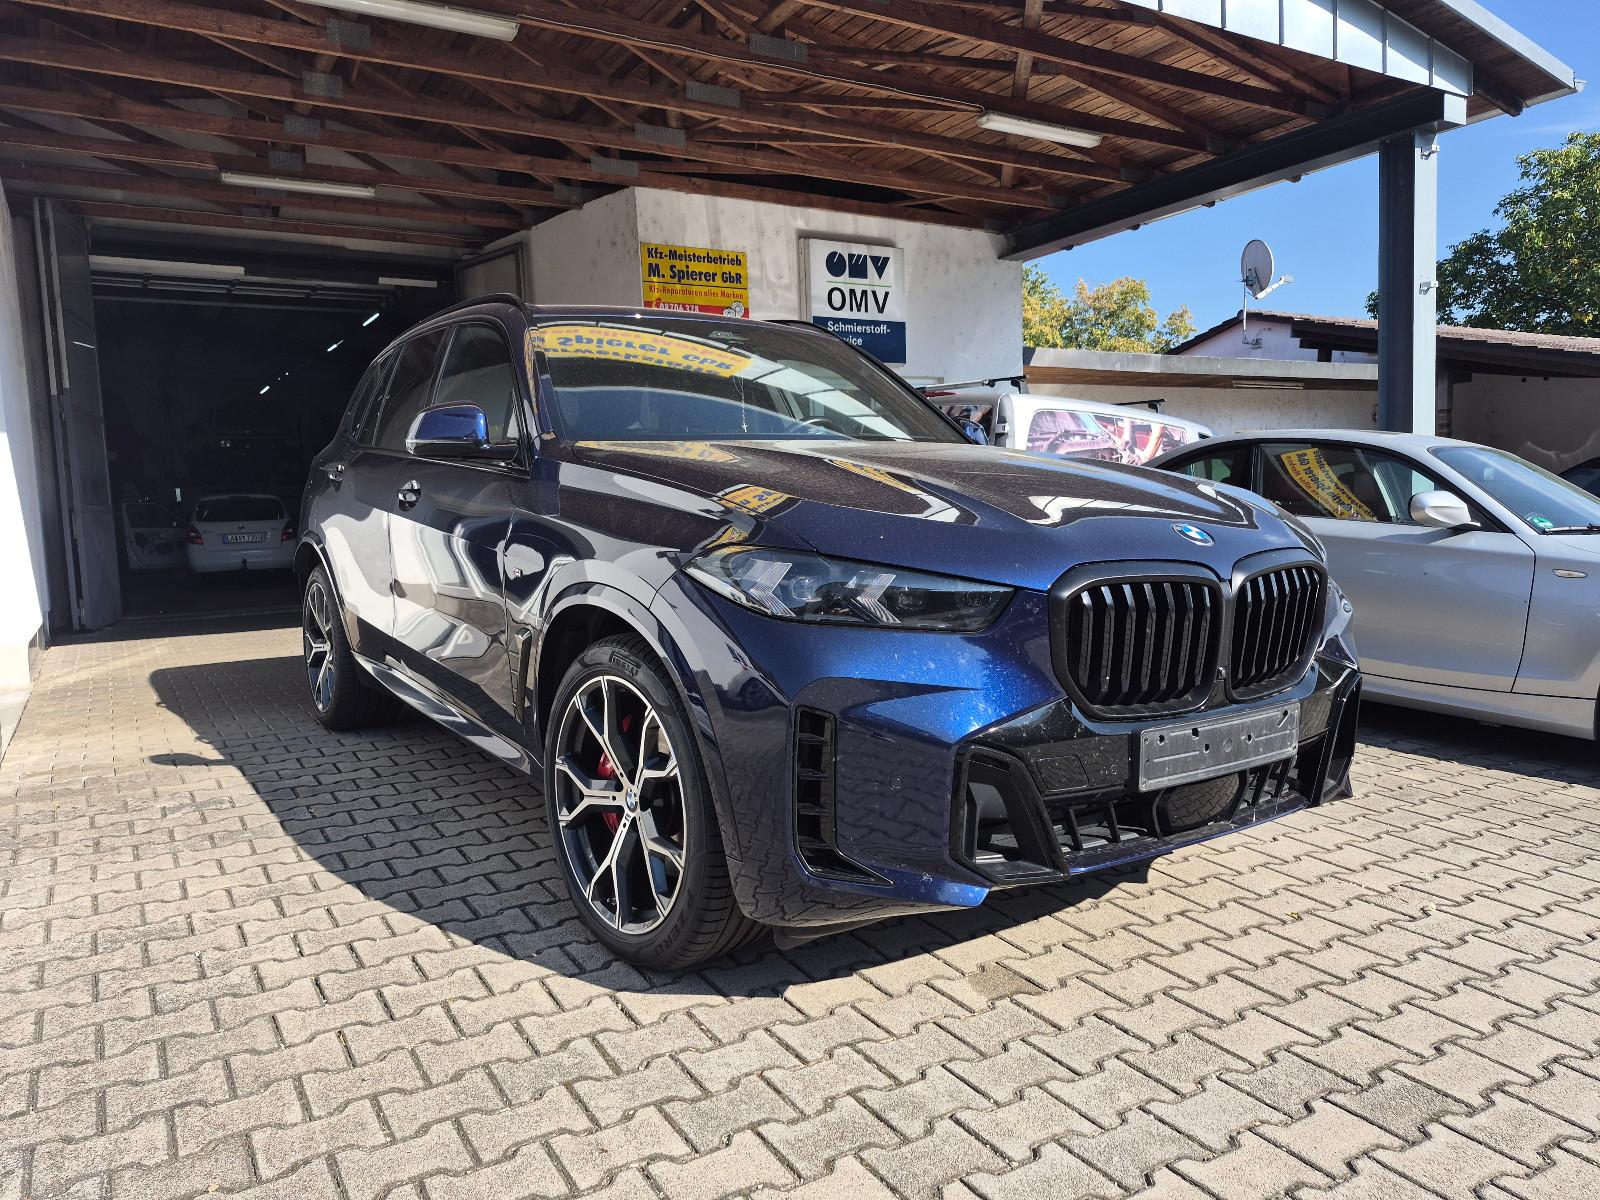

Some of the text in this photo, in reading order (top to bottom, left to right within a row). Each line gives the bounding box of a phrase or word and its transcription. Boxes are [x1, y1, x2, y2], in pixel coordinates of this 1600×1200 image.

[646, 246, 742, 267] Kfz-Meisterbetrieb
[647, 262, 743, 285] M. Spierer GbR
[649, 285, 703, 298] Kfz-Reparaturen
[720, 290, 744, 300] Marken
[827, 286, 889, 314] OMV
[827, 320, 890, 335] Schmierstoff-
